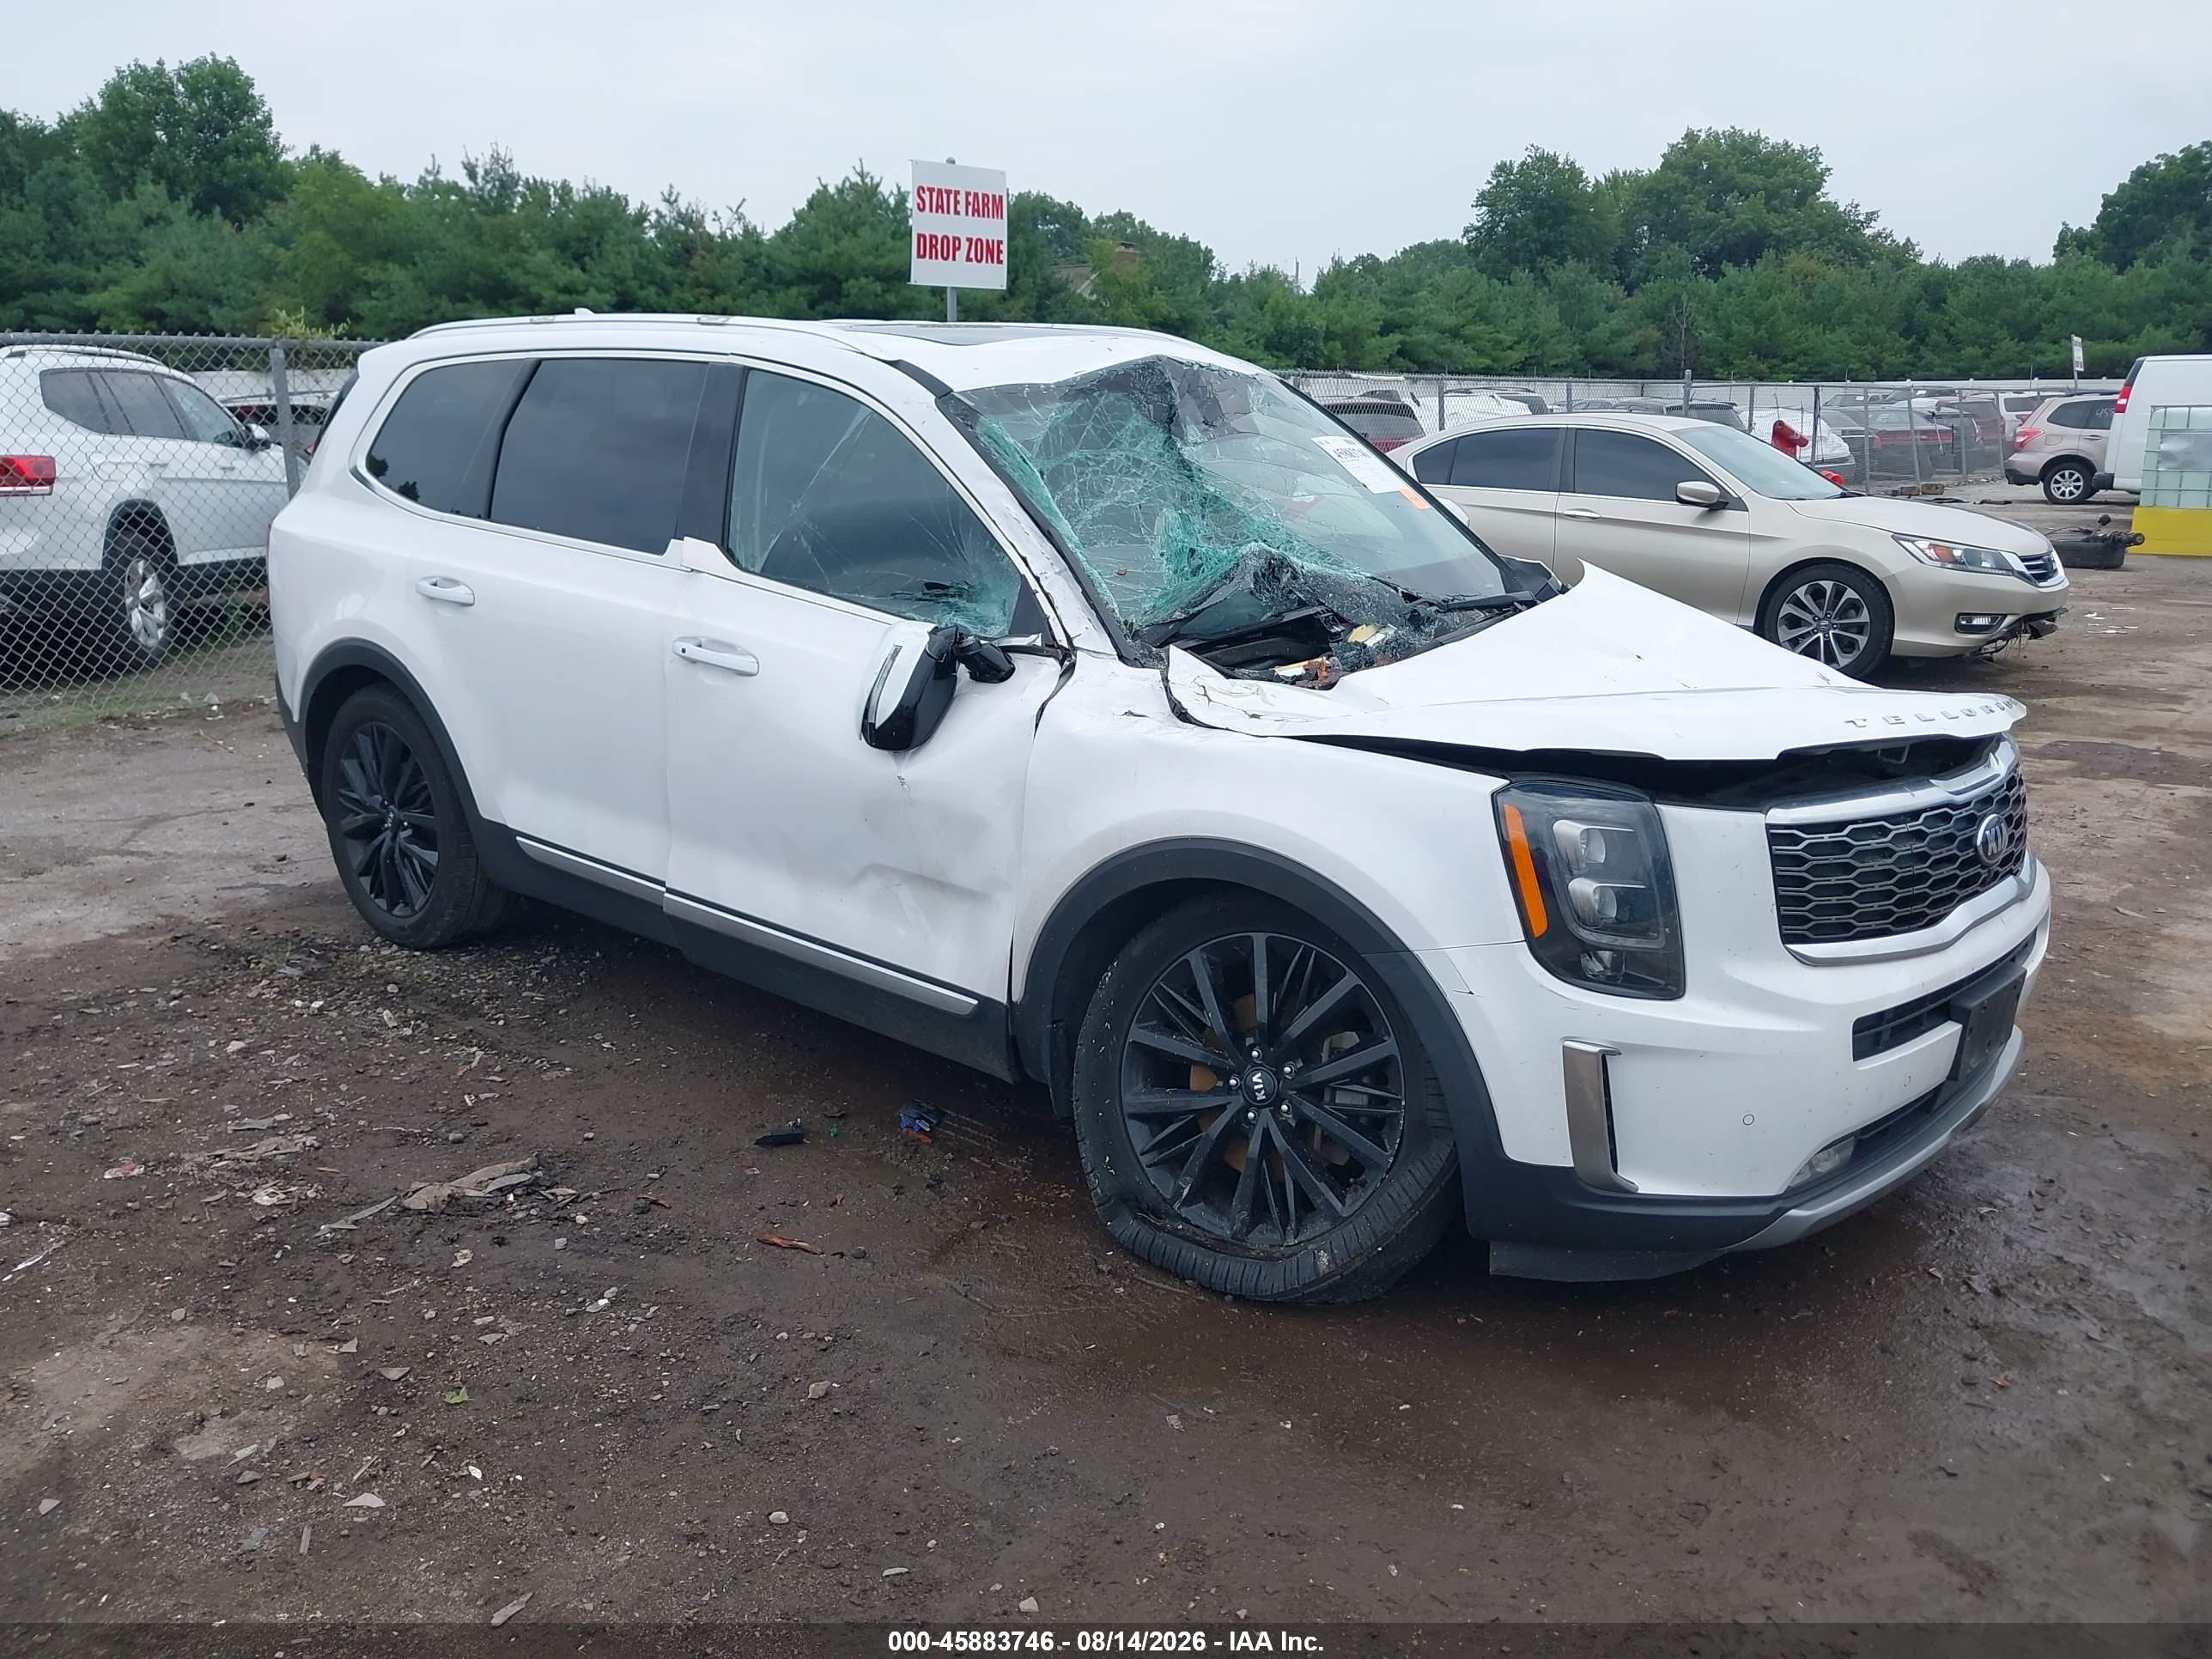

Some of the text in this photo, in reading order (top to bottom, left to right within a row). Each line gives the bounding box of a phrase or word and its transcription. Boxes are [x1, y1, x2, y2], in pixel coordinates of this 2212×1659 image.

[916, 185, 1004, 220] STATE FARM
[916, 233, 1004, 264] DROP ZONE
[1252, 1072, 1267, 1101] KIA
